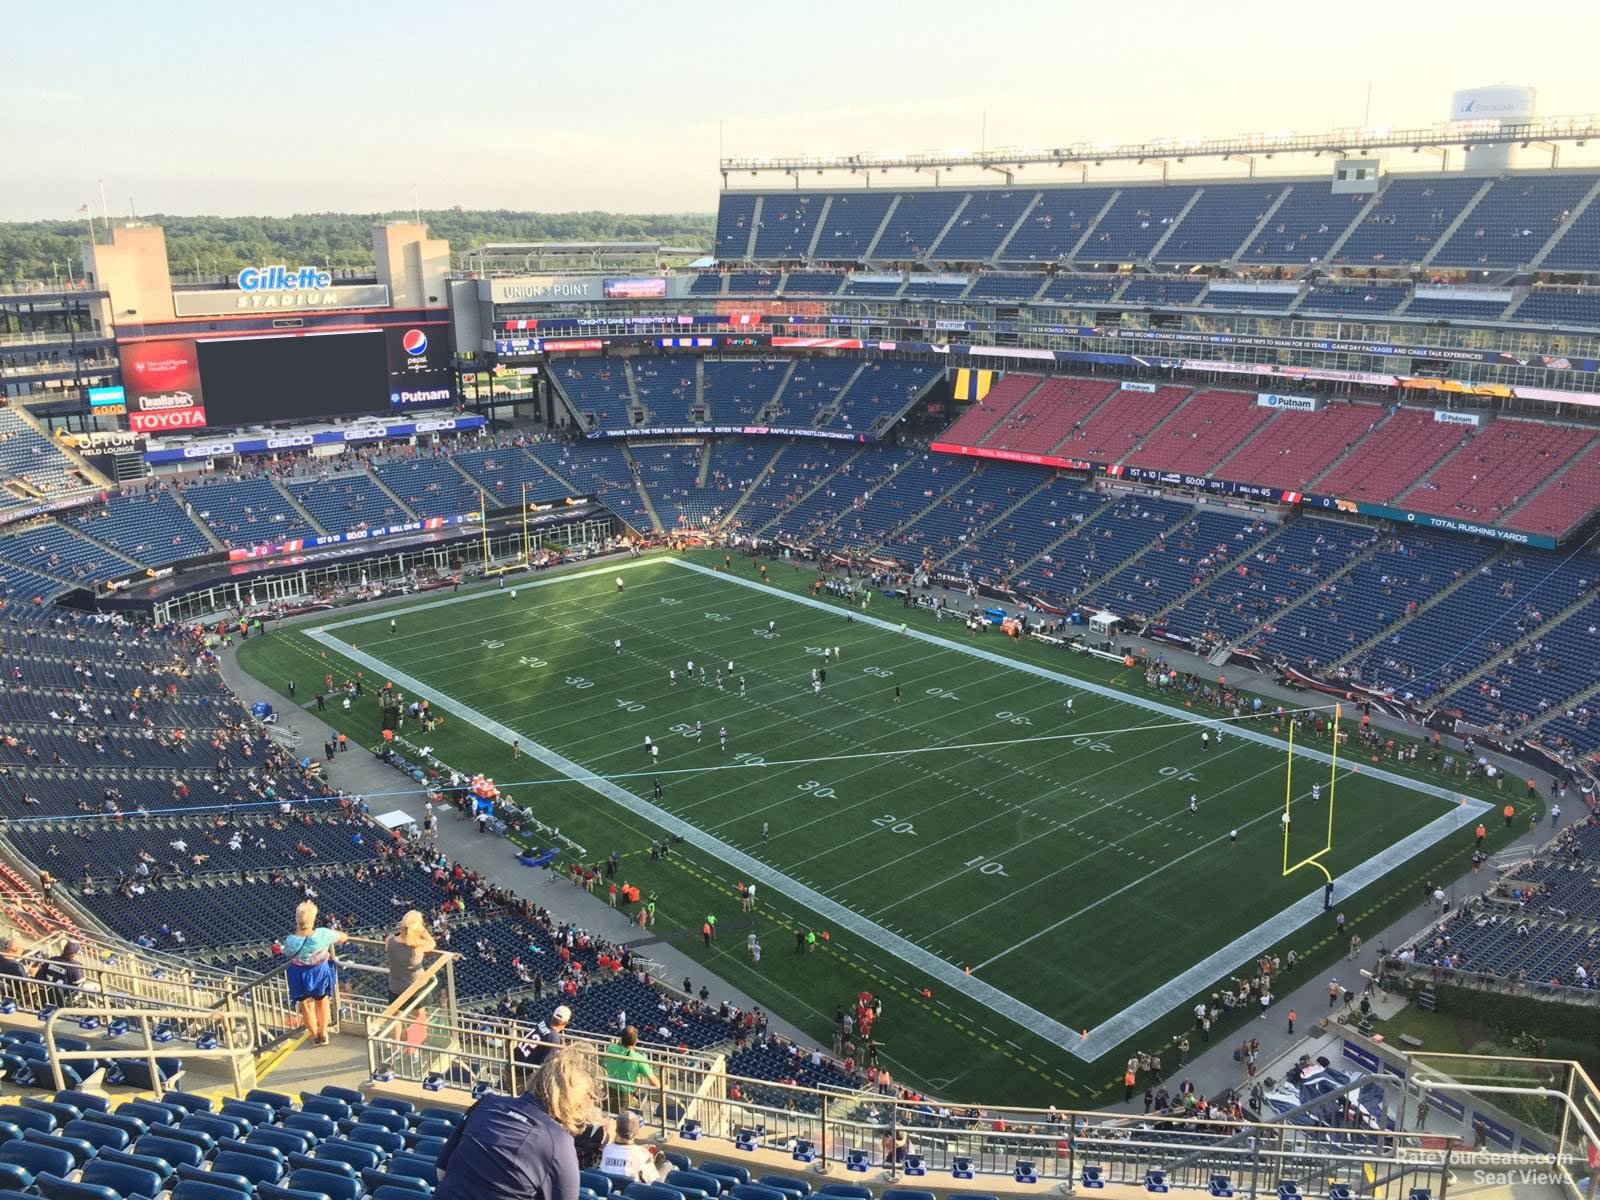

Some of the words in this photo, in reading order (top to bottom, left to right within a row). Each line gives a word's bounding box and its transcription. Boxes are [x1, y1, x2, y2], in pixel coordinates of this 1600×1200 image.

[238, 265, 332, 292] Gillette
[505, 286, 542, 298] UNION
[553, 284, 589, 296] POINT
[237, 293, 337, 308] STADIUM
[401, 389, 450, 403] Putnam
[1278, 397, 1311, 408] Putnam
[133, 410, 206, 429] TOYOTA
[415, 419, 456, 433] GEICO
[1448, 414, 1472, 424] Putnam
[344, 427, 387, 441] GEICO
[79, 435, 136, 449] OPTUM
[267, 435, 314, 449] GEICO
[80, 448, 102, 457] FIELD
[103, 445, 136, 454] LOUNGE
[183, 443, 235, 457] GEICO
[1130, 468, 1140, 476] 1ST
[1185, 476, 1206, 486] 60:00
[1260, 488, 1271, 497] 45
[1323, 498, 1330, 506] 0
[1407, 513, 1414, 521] 0
[1430, 518, 1456, 530] TOTAL
[1458, 523, 1496, 537] RUSHING
[1496, 530, 1528, 543] YARDS
[863, 666, 894, 678] 50
[616, 698, 646, 712] 40
[797, 780, 835, 798] 30
[872, 814, 913, 833] 20
[963, 856, 1003, 876] 10
